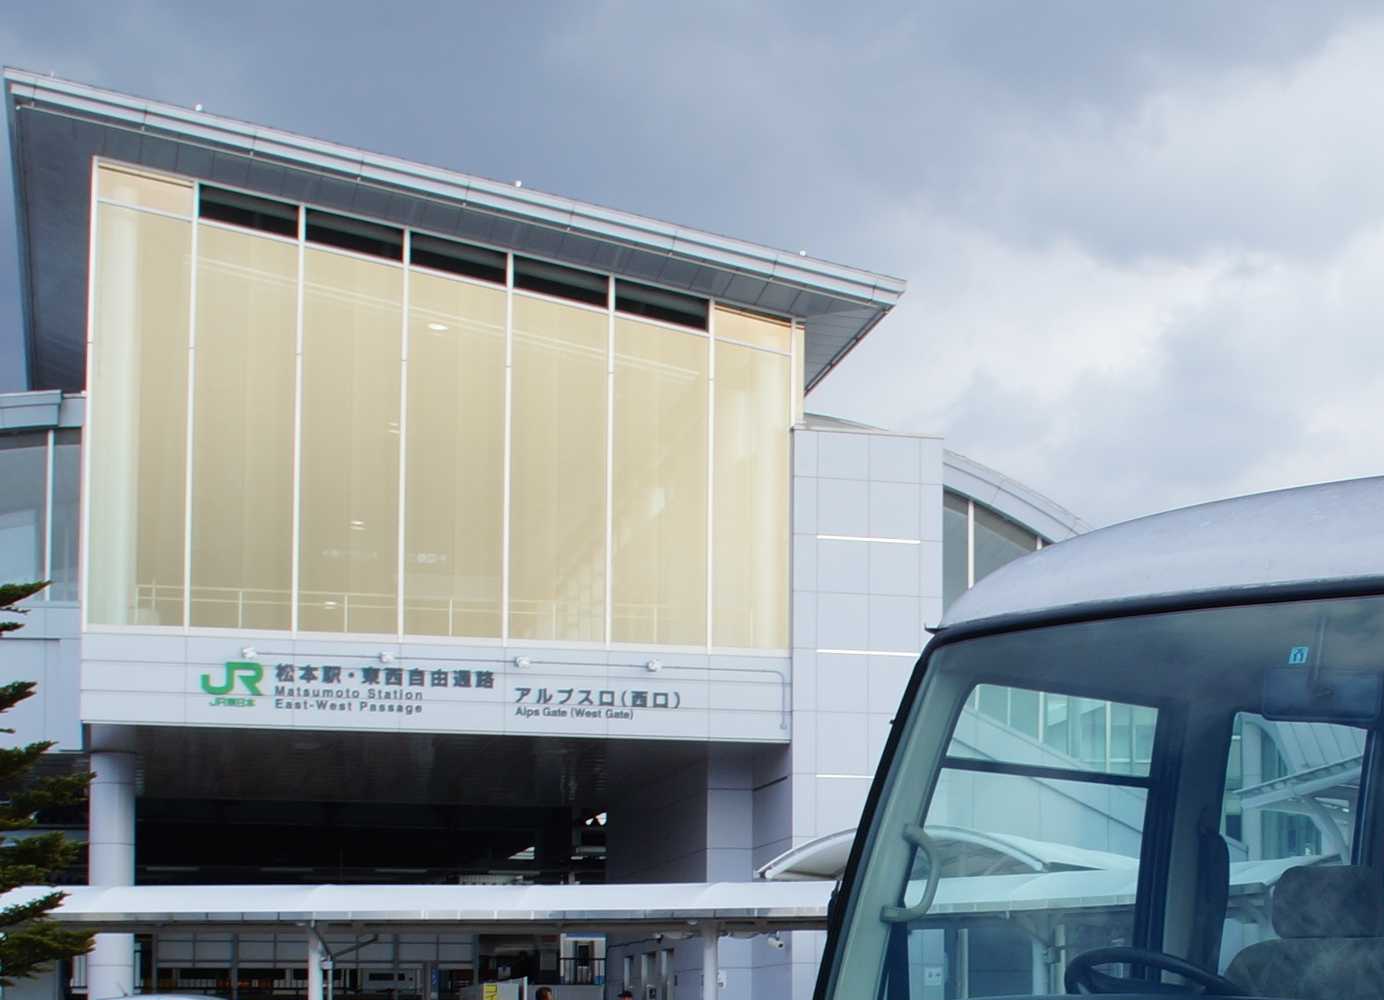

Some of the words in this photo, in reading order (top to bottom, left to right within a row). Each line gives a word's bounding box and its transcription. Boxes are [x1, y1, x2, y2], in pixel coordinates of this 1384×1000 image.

[200, 662, 263, 697] JR
[275, 686, 360, 699] Matsumoto
[367, 688, 423, 701] Station
[275, 698, 352, 711] East-West
[360, 701, 423, 715] Passage
[515, 706, 540, 719] Alps
[543, 708, 568, 718] Gate
[570, 707, 602, 719] (West
[605, 708, 634, 720] Gate)
